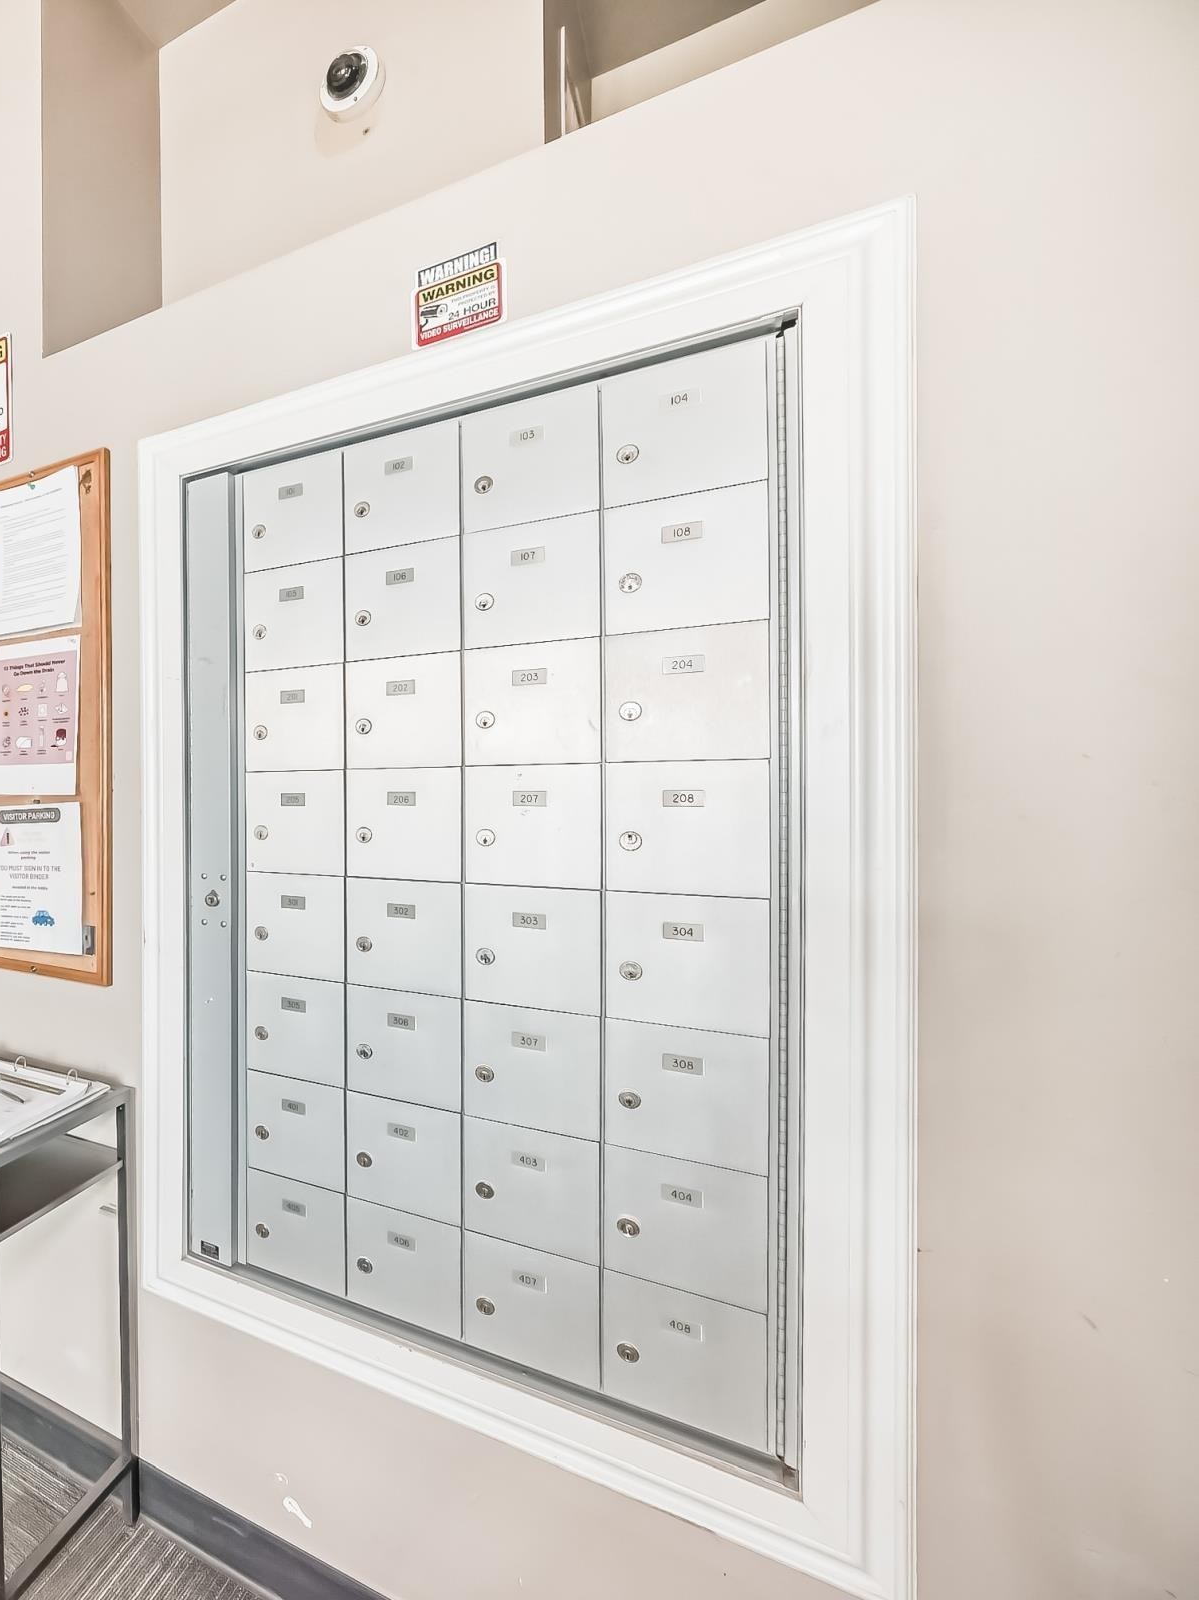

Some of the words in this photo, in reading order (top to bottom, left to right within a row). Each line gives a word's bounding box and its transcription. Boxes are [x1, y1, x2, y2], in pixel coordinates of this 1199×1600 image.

[419, 244, 495, 285] WARNING!
[422, 268, 495, 303] WARNING
[448, 310, 460, 320] 24
[463, 297, 496, 315] HOUR
[419, 326, 442, 340] VIDEO
[442, 308, 499, 333] SURVEILLANCE
[671, 393, 688, 405] 104
[520, 430, 534, 441] 103
[392, 461, 405, 470] 102
[674, 527, 690, 537] 108
[521, 552, 535, 560] 107
[394, 572, 406, 581] 106
[672, 660, 693, 669] 204
[521, 673, 538, 682] 203
[393, 684, 408, 692] 202
[394, 796, 409, 804] 206
[521, 795, 538, 803] 207
[673, 794, 694, 803] 208
[3, 813, 27, 821] VISITOR
[28, 811, 55, 820] PARKING
[394, 907, 408, 915] 302
[521, 916, 538, 925] 303
[673, 927, 693, 936] 304
[521, 1036, 537, 1046] 307
[673, 1059, 693, 1069] 308
[394, 1127, 409, 1137] 402
[520, 1156, 537, 1167] 403
[671, 1190, 691, 1202] 404
[519, 1275, 536, 1286] 407
[670, 1320, 690, 1333] 408
